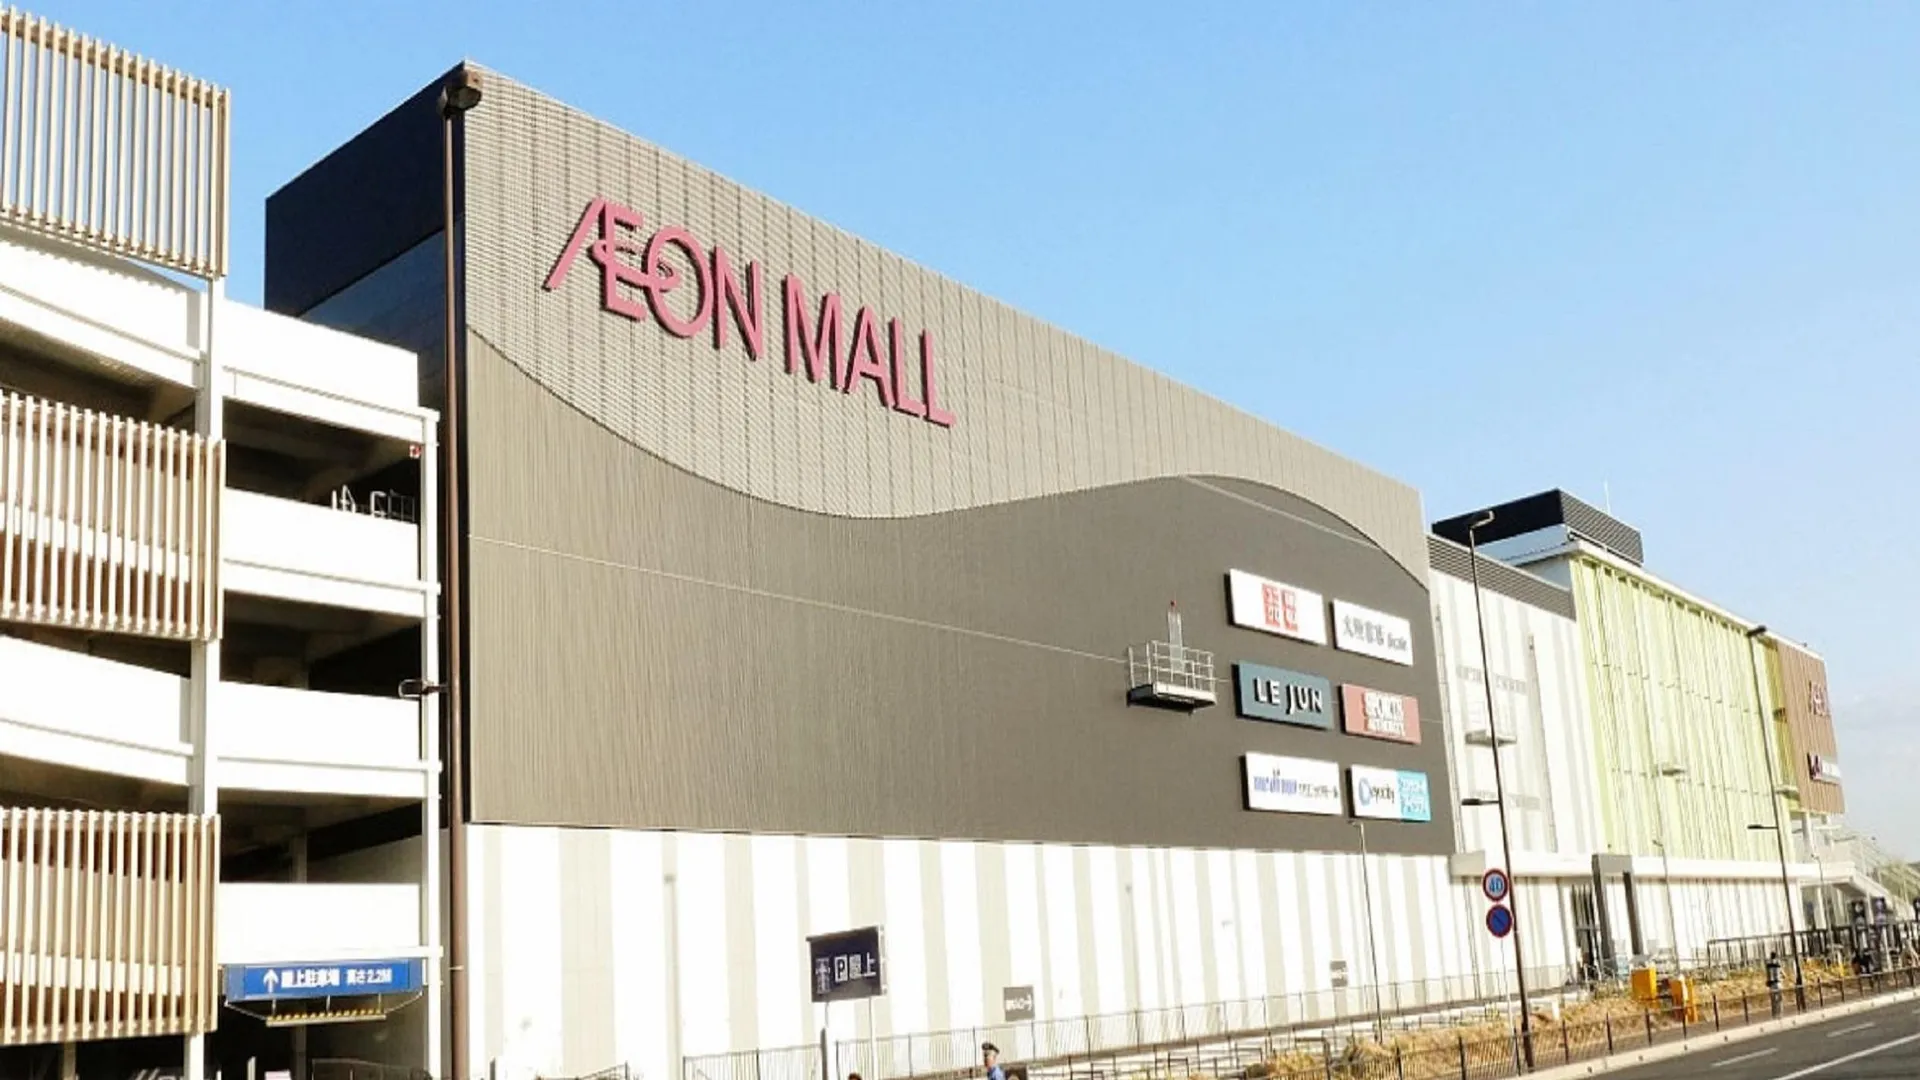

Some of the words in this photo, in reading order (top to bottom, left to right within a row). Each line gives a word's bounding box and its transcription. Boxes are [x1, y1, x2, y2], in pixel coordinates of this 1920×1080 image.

[782, 273, 956, 428] MALL
[1255, 676, 1281, 704] LE
[1286, 683, 1323, 714] JUN
[1489, 876, 1503, 893] 40
[849, 952, 877, 980] 上
